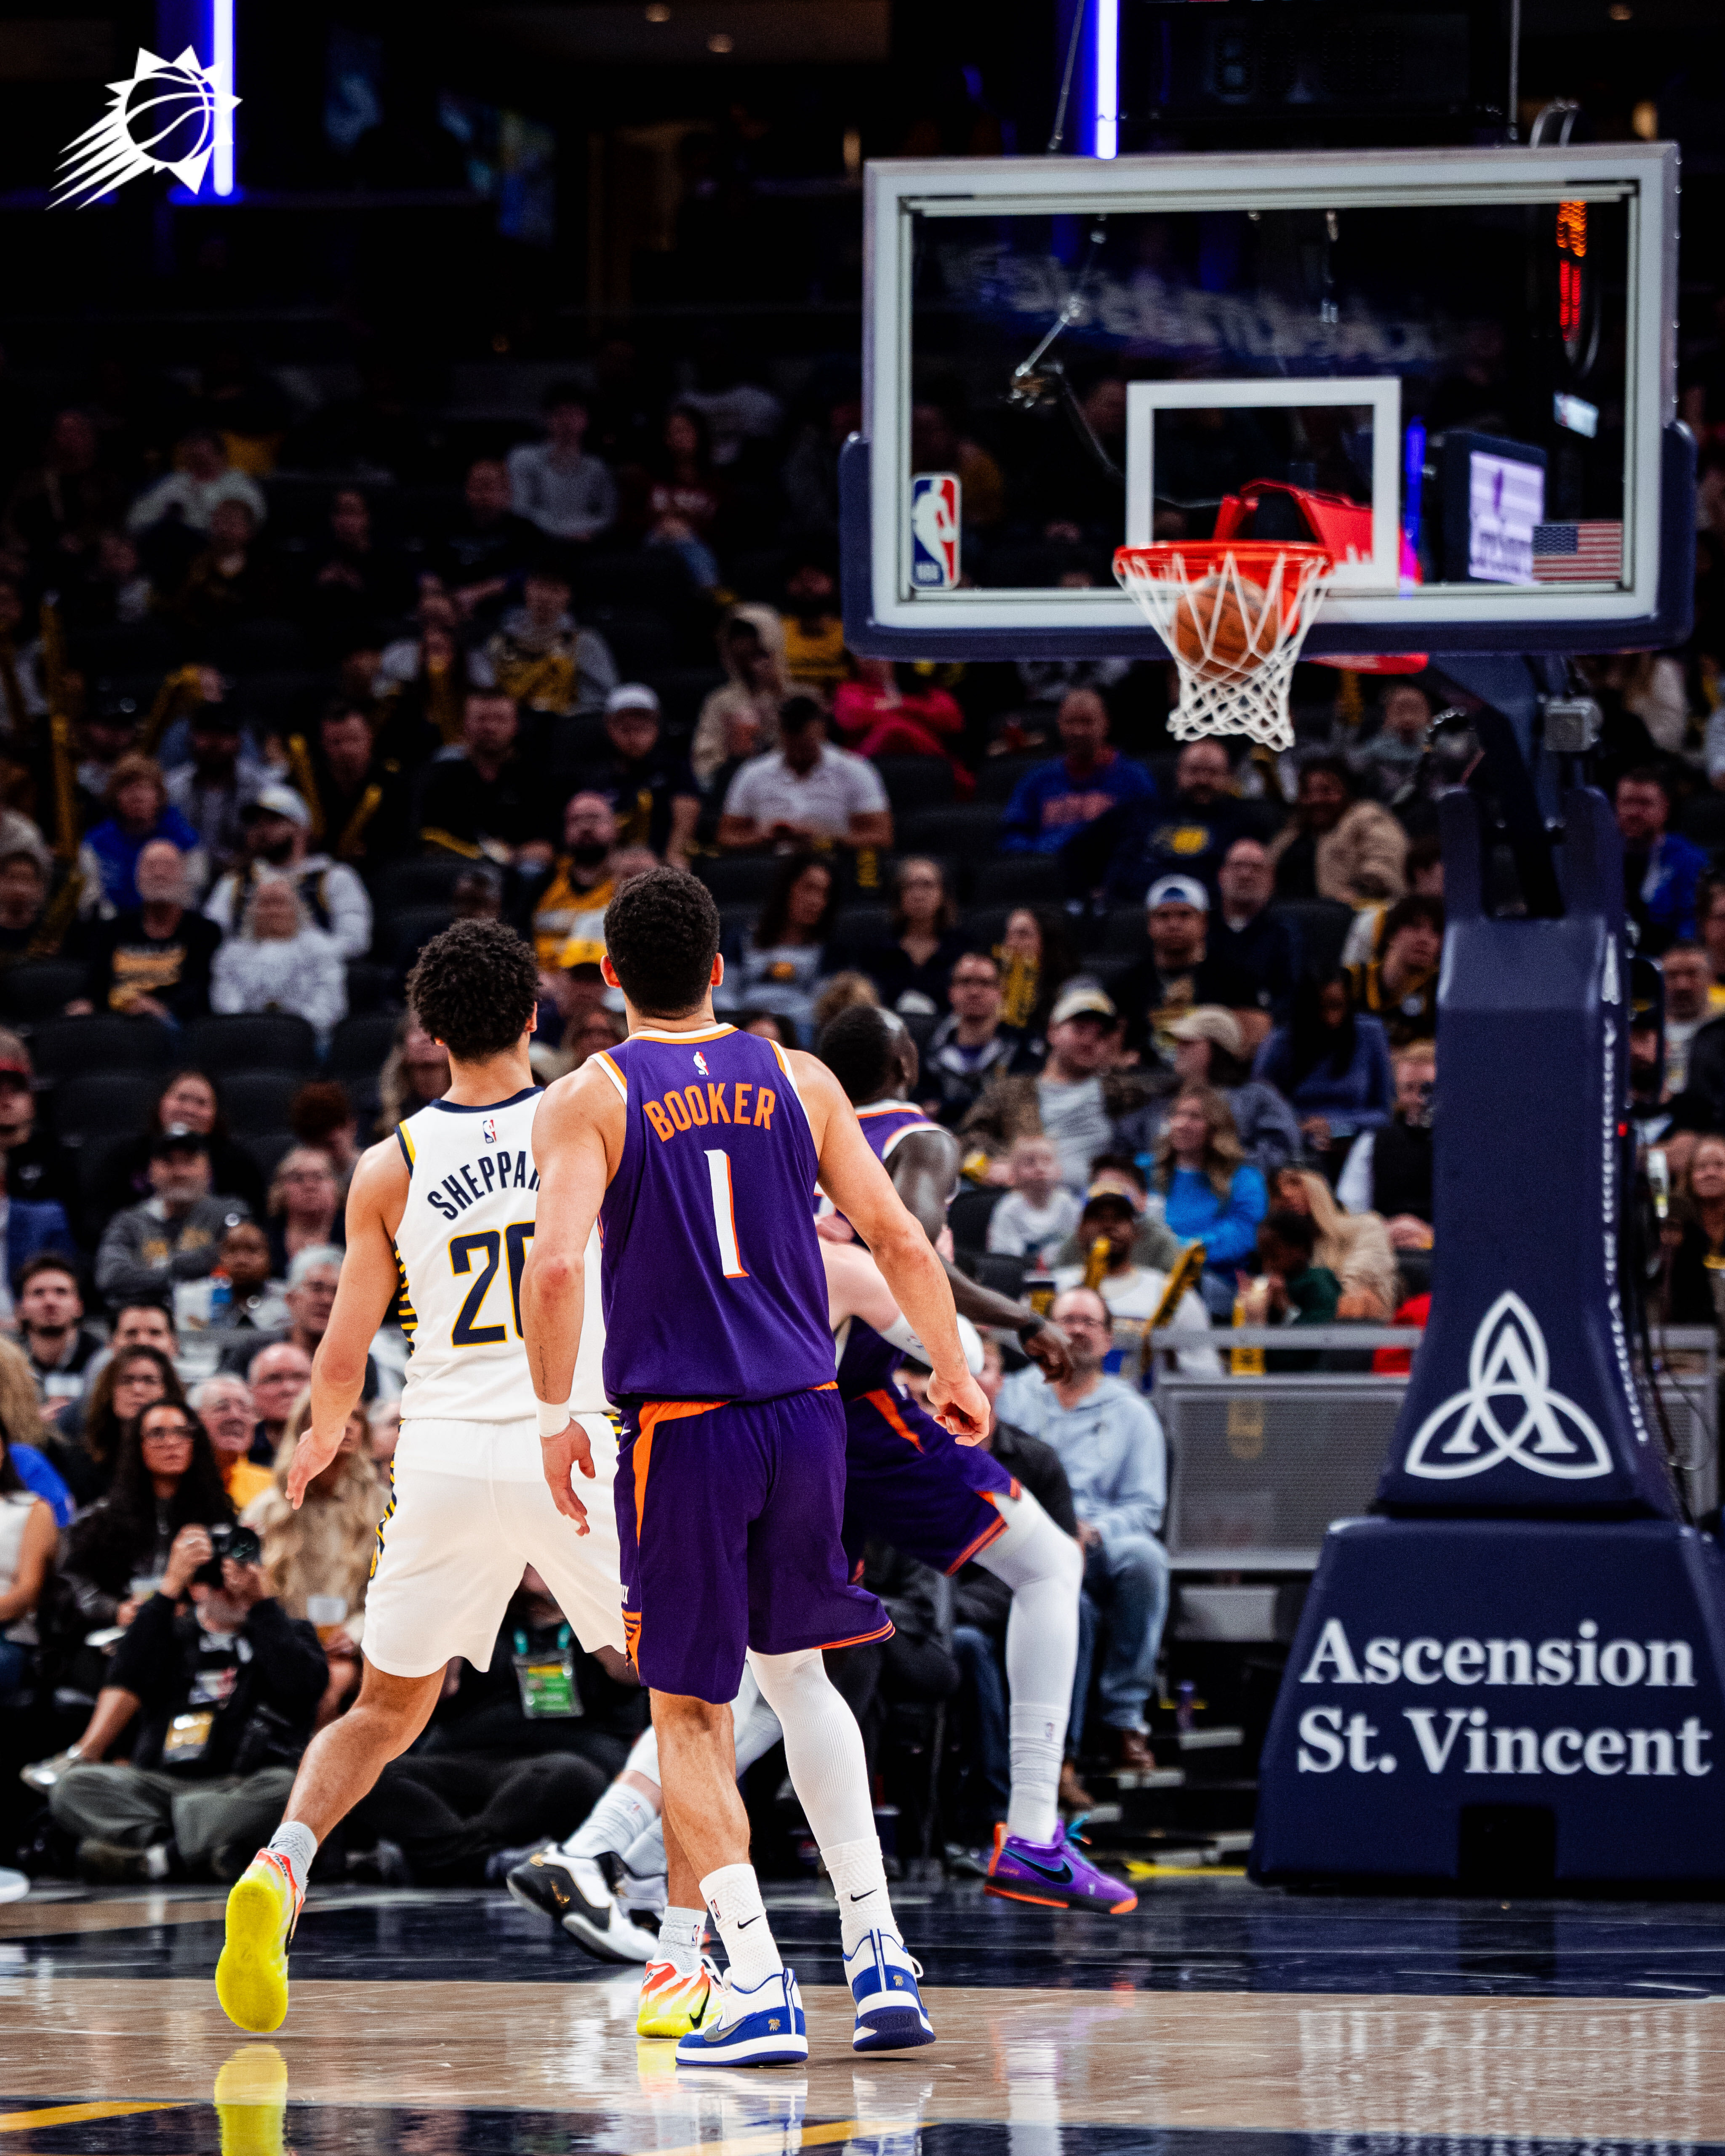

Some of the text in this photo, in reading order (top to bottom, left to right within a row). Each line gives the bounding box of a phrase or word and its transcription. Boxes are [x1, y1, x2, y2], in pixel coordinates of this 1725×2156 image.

[643, 1082, 776, 1142] BOOKER
[704, 1149, 749, 1279] 1
[1300, 1618, 1696, 1687] Ascension
[1298, 1707, 1712, 1776] St. Vincent
